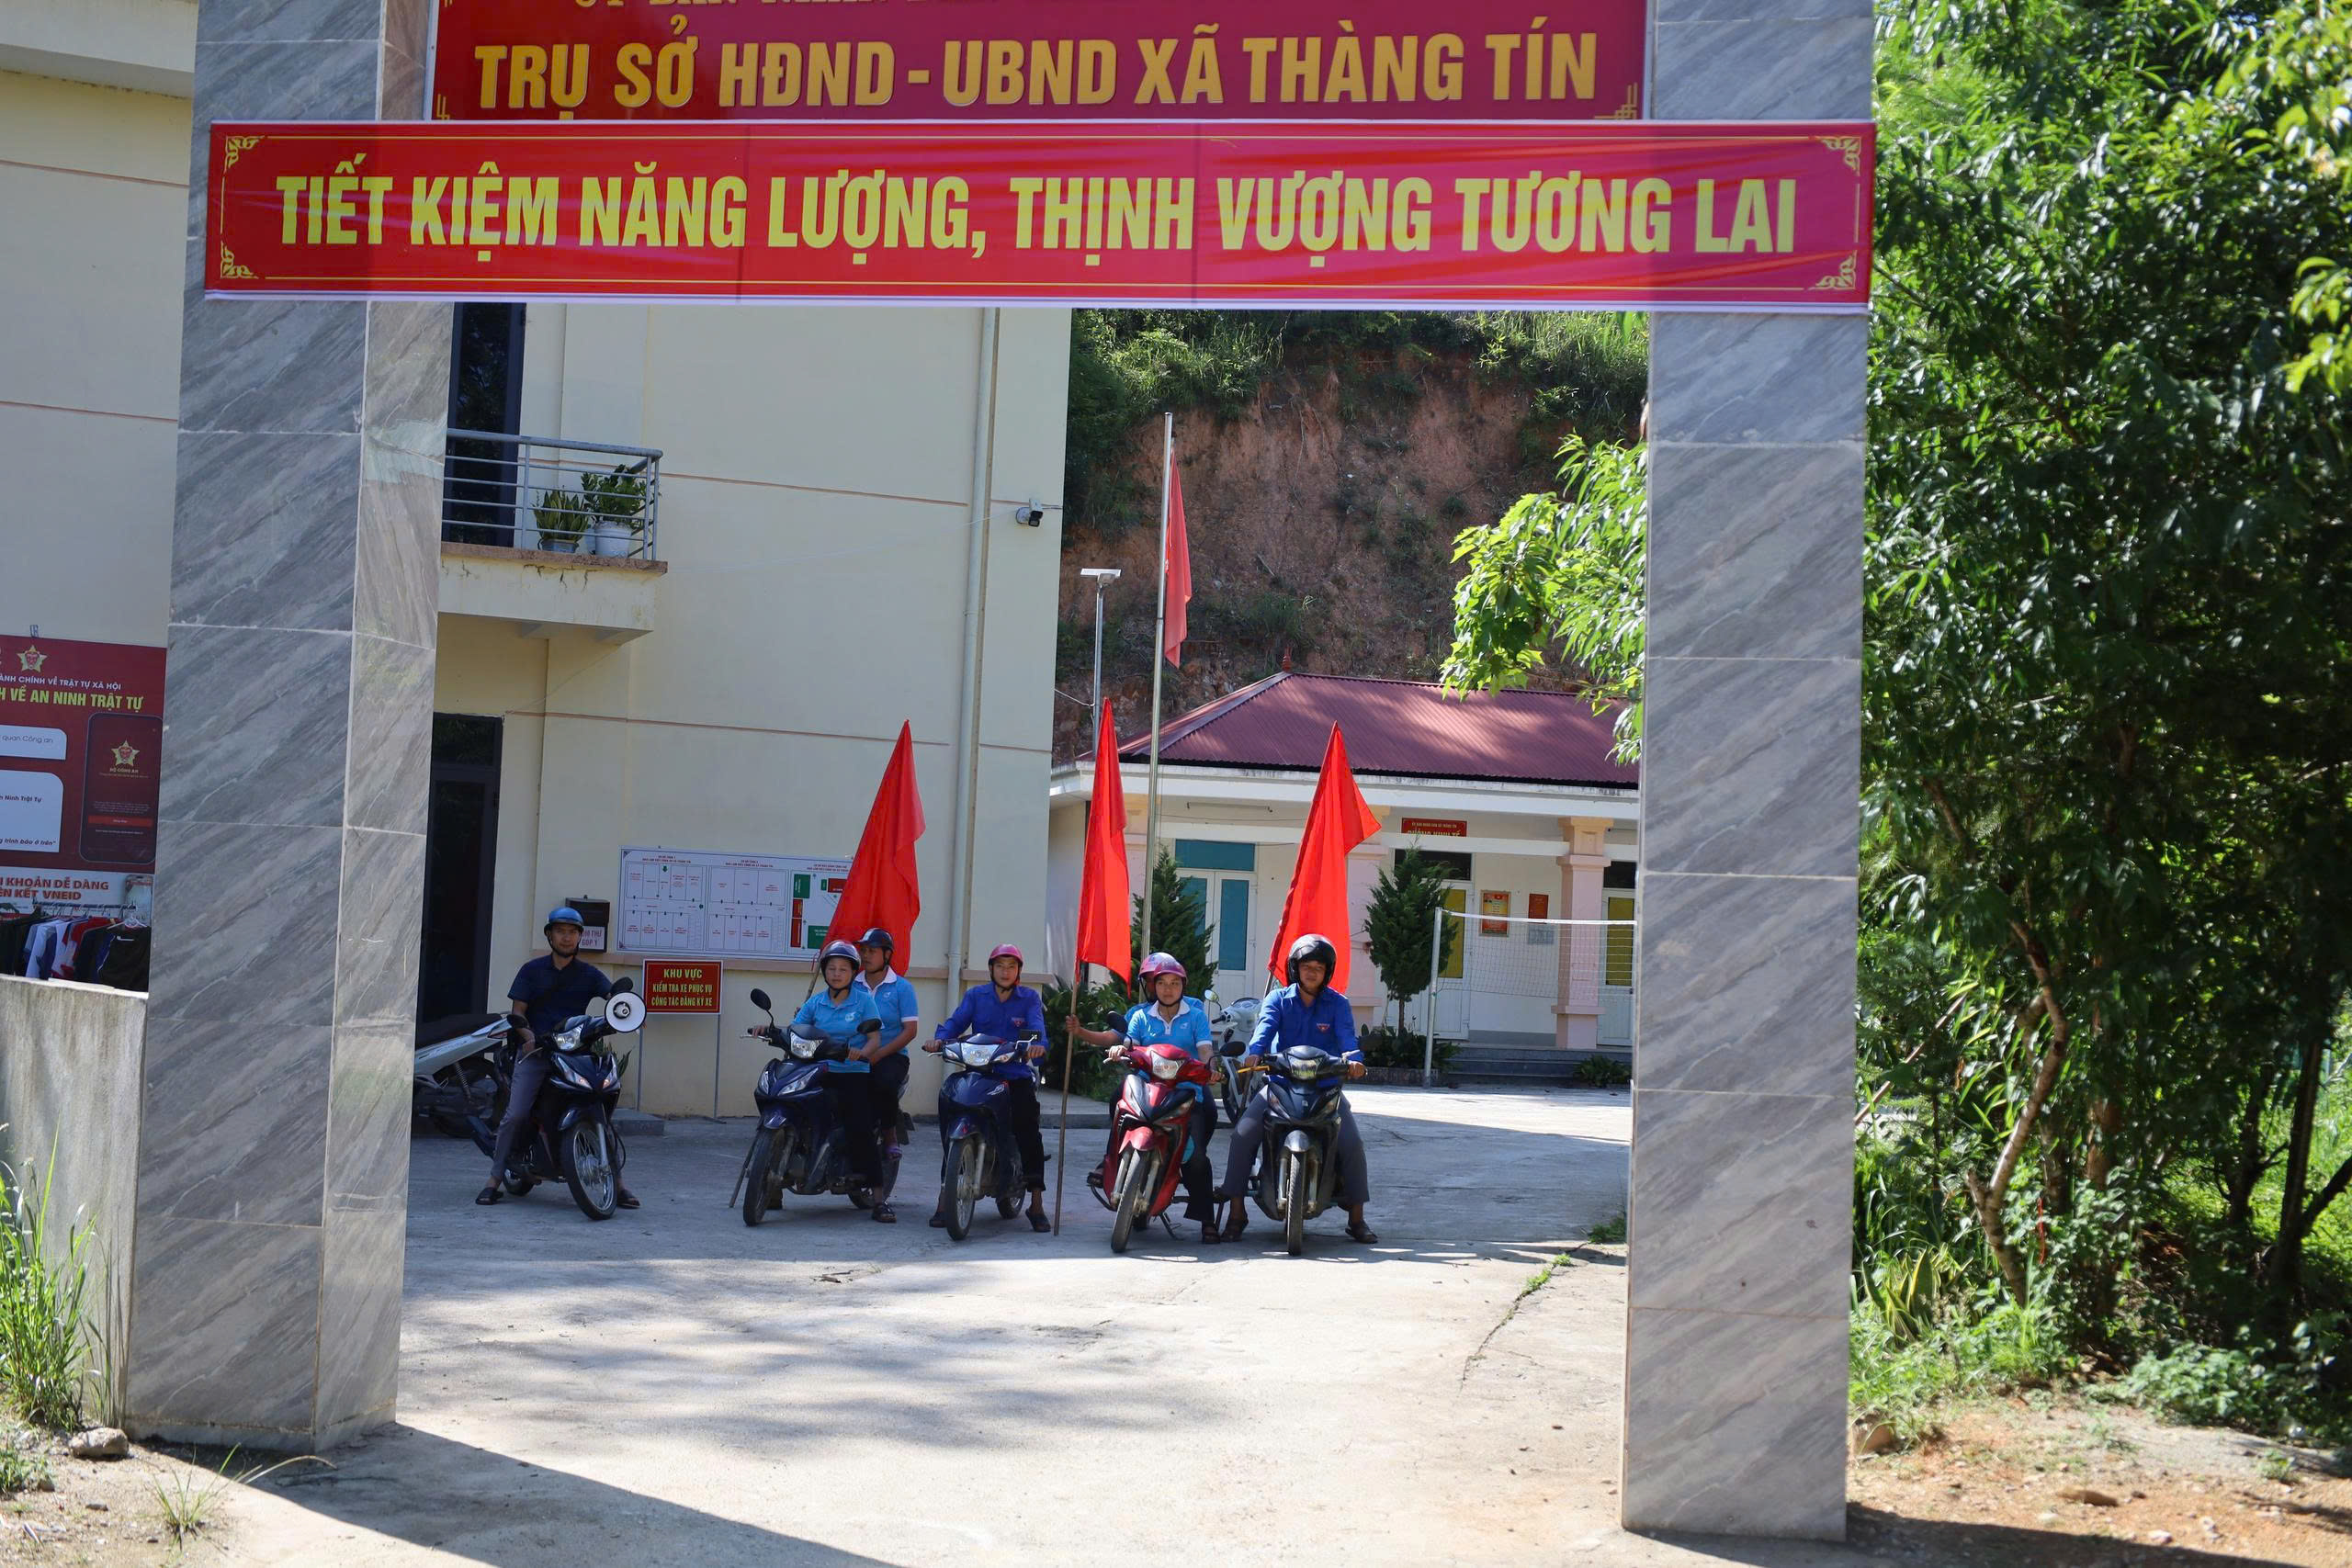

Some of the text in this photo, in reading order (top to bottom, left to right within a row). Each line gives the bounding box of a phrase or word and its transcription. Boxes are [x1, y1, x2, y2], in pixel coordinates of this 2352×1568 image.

[475, 44, 590, 119] TRỤ
[614, 14, 699, 107] SỞ
[719, 41, 895, 107] HĐND
[944, 39, 1117, 107] UBND
[1134, 23, 1224, 105] XÃ
[1242, 19, 1464, 103] THÀNG
[1485, 16, 1597, 101] TÍN
[276, 152, 1796, 267] TIẾT KIỆM NĂNG LƯỢNG, THỊNH VƯỢNG TƯƠNG LAI
[18, 675, 46, 684] CHÍNH
[60, 678, 79, 689] TRẬT
[80, 681, 91, 690] TỰ
[92, 681, 104, 689] XÃ
[106, 682, 121, 692] HỘI
[29, 690, 50, 704] AN
[53, 691, 86, 706] NINH
[90, 692, 123, 711] TRẬT
[126, 695, 144, 713] TỰ
[6, 875, 51, 888] KHOẢN
[74, 878, 109, 890] DÀNG
[15, 886, 39, 899] KẾT
[42, 890, 82, 900] VNEID
[663, 968, 703, 981] KHU VỰC
[652, 979, 713, 995] KIỂM TRA XE PHỤC VỤ
[651, 994, 668, 1006] CÔNG
[668, 995, 680, 1006] TÁC
[680, 995, 696, 1007] ĐĂNG
[705, 997, 713, 1007] XE
